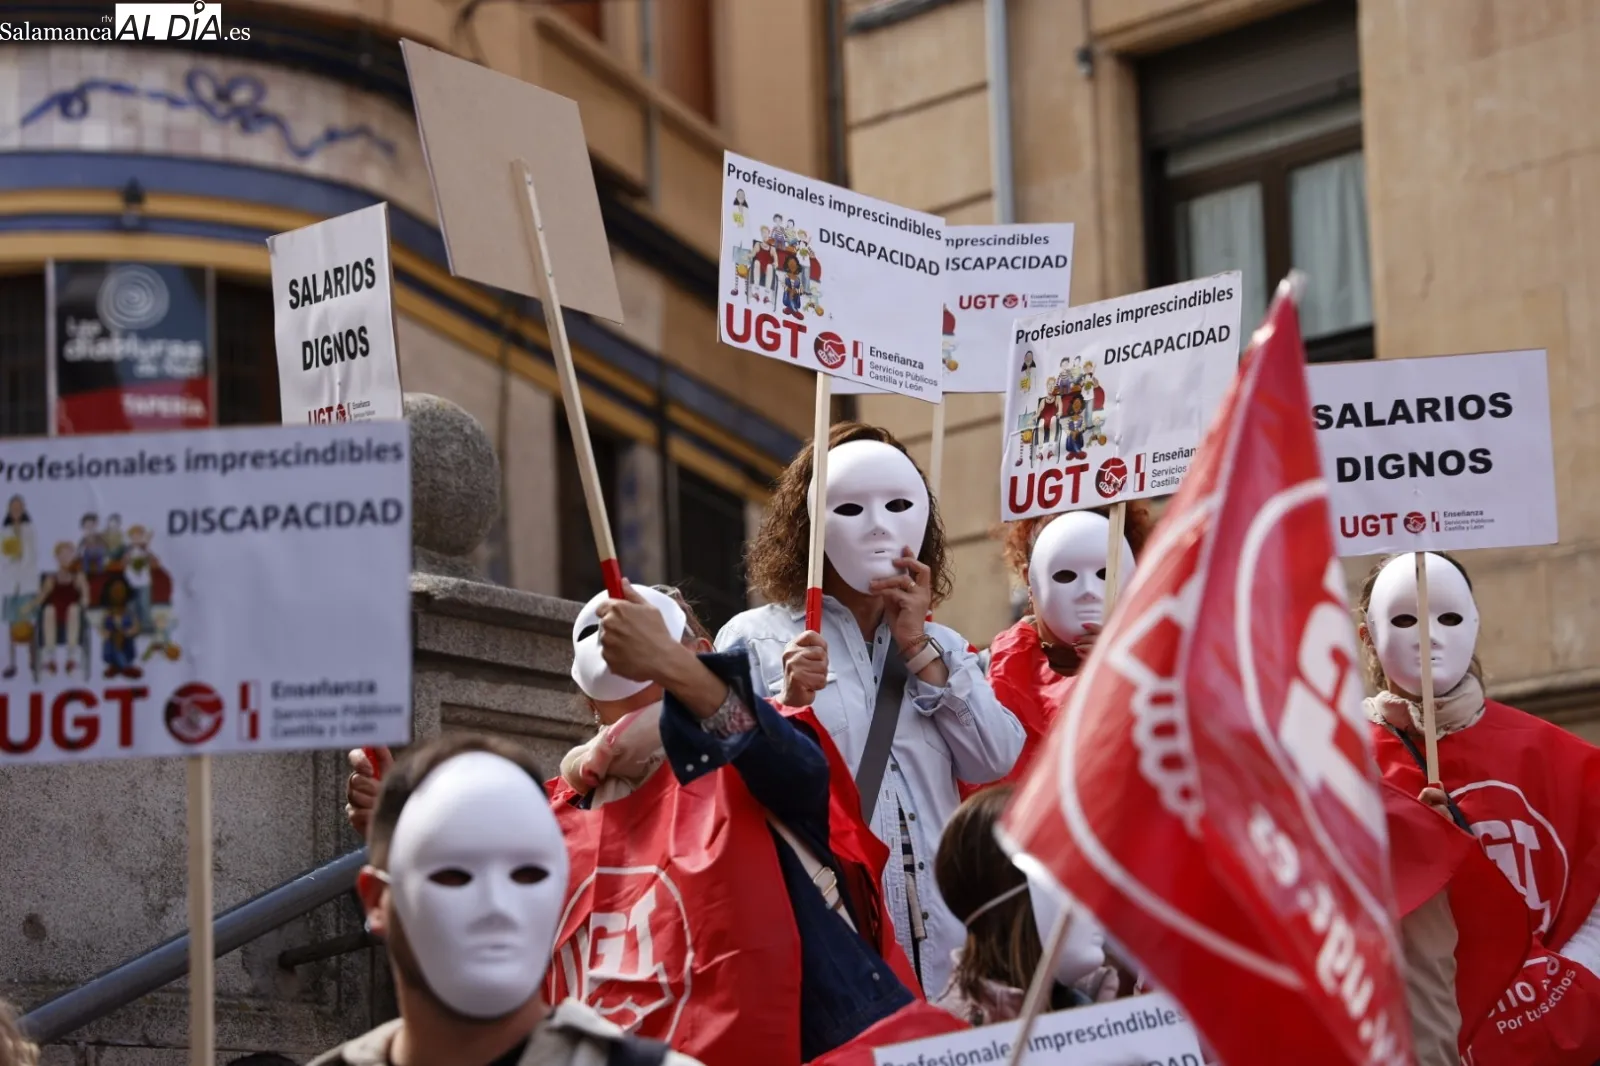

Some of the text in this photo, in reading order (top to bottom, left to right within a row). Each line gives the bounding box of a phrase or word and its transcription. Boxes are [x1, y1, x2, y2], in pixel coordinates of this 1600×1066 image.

[727, 162, 942, 241] Profesionales imprescindibles
[819, 228, 940, 276] DISCAPACIDAD
[945, 233, 1050, 251] mprescindibles
[945, 254, 1068, 271] ISCAPACIDAD
[289, 257, 376, 310] SALARIOS
[958, 294, 999, 310] UGT
[1015, 286, 1234, 344] Profesionales imprescindibles
[302, 326, 370, 371] DIGNOS
[726, 303, 807, 359] UGT
[1104, 325, 1231, 365] DISCAPACIDAD
[870, 346, 924, 370] Enseñanza
[870, 361, 938, 386] Servicios Públicos
[869, 371, 897, 385] Castilla
[905, 381, 923, 392] León
[1312, 392, 1513, 430] SALARIOS
[185, 437, 404, 476] imprescindibles
[1152, 447, 1197, 463] Enseñan
[1152, 465, 1187, 477] Servicios
[1336, 448, 1493, 483] DIGNOS
[1008, 463, 1090, 514] UGT
[1151, 476, 1179, 488] Castilla
[167, 498, 402, 536] DISCAPACIDAD
[1340, 513, 1398, 538] UGT
[0, 686, 149, 754] UGT
[1496, 1015, 1523, 1034] Por
